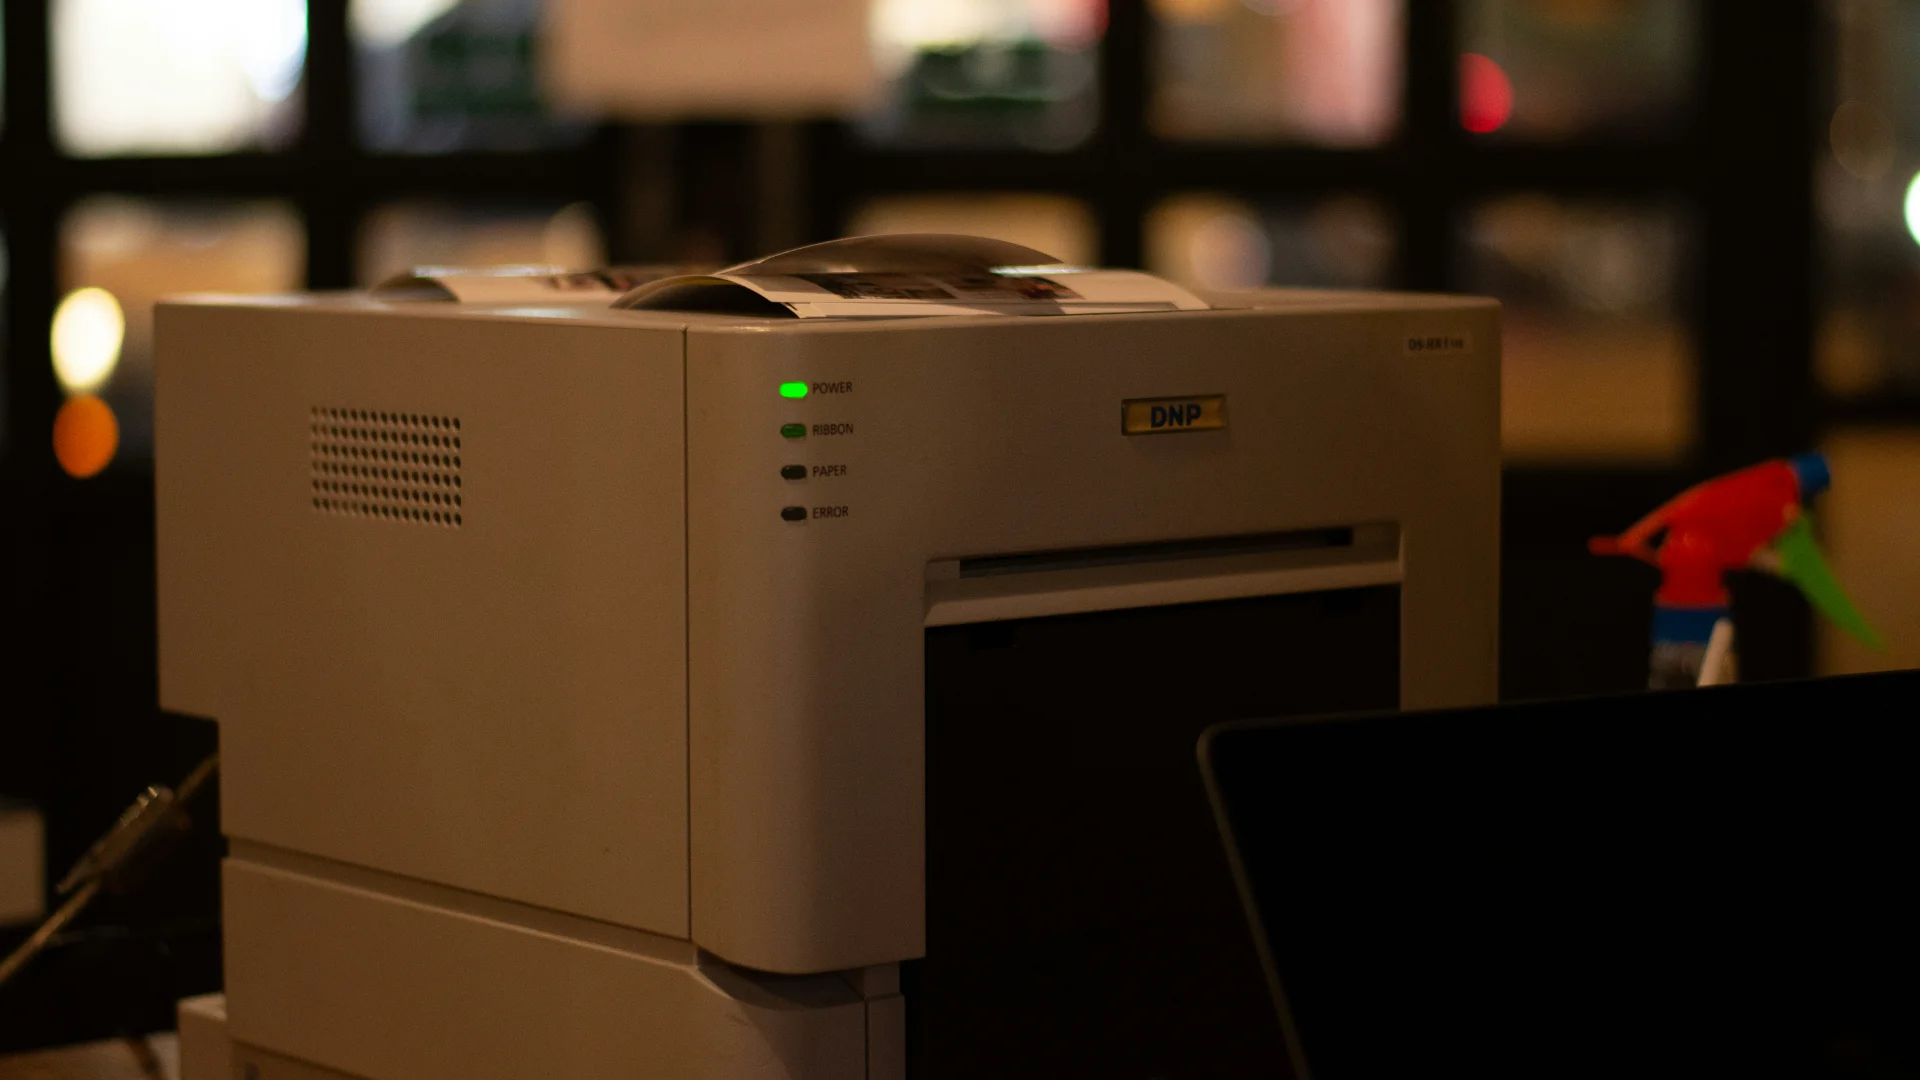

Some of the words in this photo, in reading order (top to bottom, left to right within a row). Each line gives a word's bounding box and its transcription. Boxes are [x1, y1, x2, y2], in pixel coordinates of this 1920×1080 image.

[812, 382, 853, 394] POWER
[1151, 404, 1202, 428] DNP
[812, 424, 854, 436] RIBBON
[812, 465, 847, 477] PAPER
[812, 507, 849, 519] ERROR
